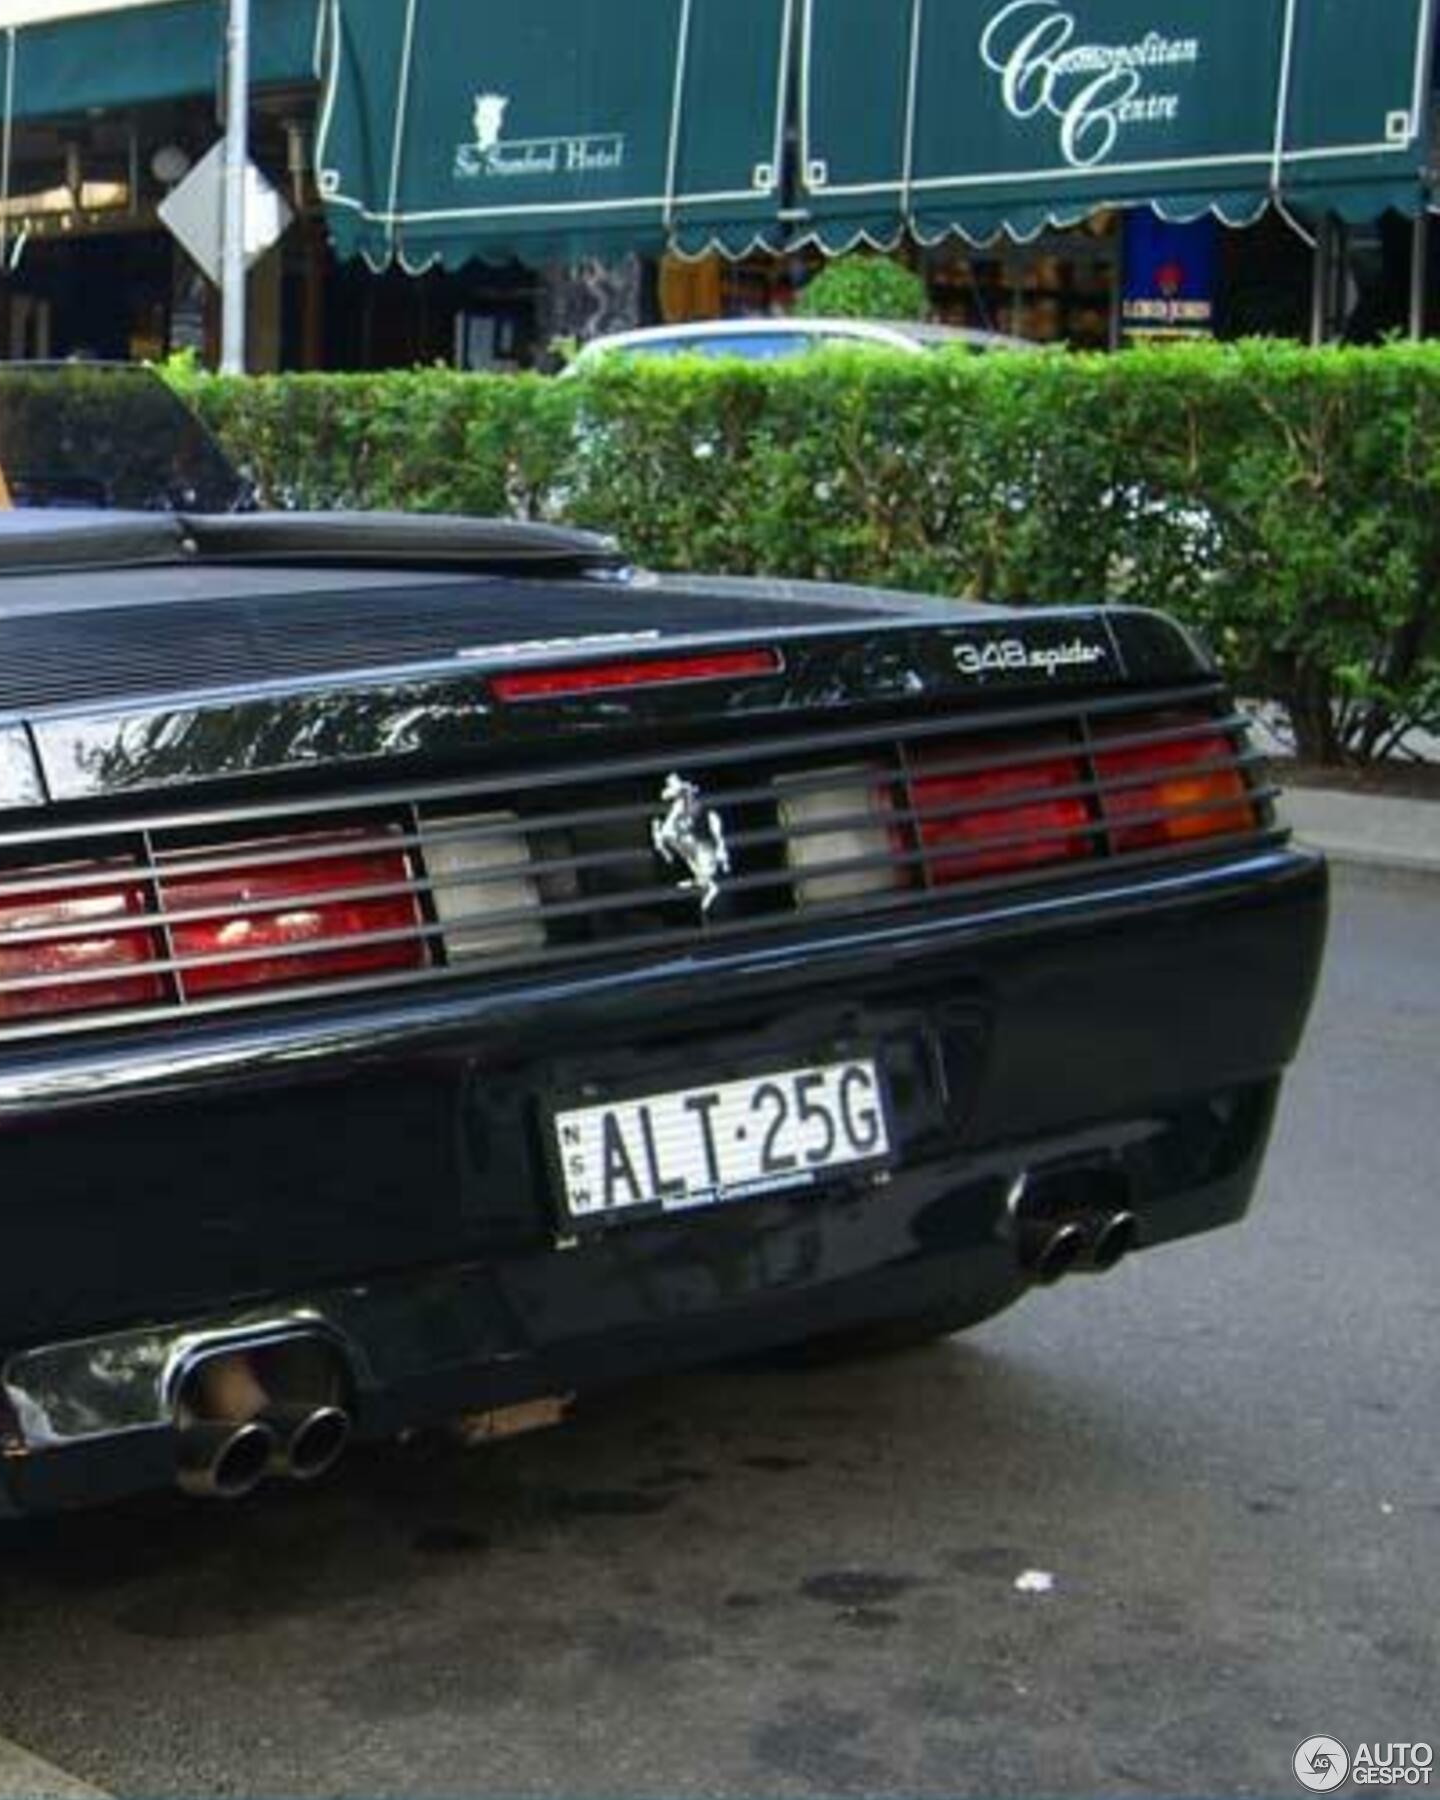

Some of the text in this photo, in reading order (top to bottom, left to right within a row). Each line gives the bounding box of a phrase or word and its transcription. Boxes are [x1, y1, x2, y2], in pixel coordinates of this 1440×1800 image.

[979, 0, 1198, 118] Cosmopolitan
[1061, 66, 1179, 167] Centre
[566, 138, 624, 170] Hotel
[952, 636, 1106, 677] 348 spider
